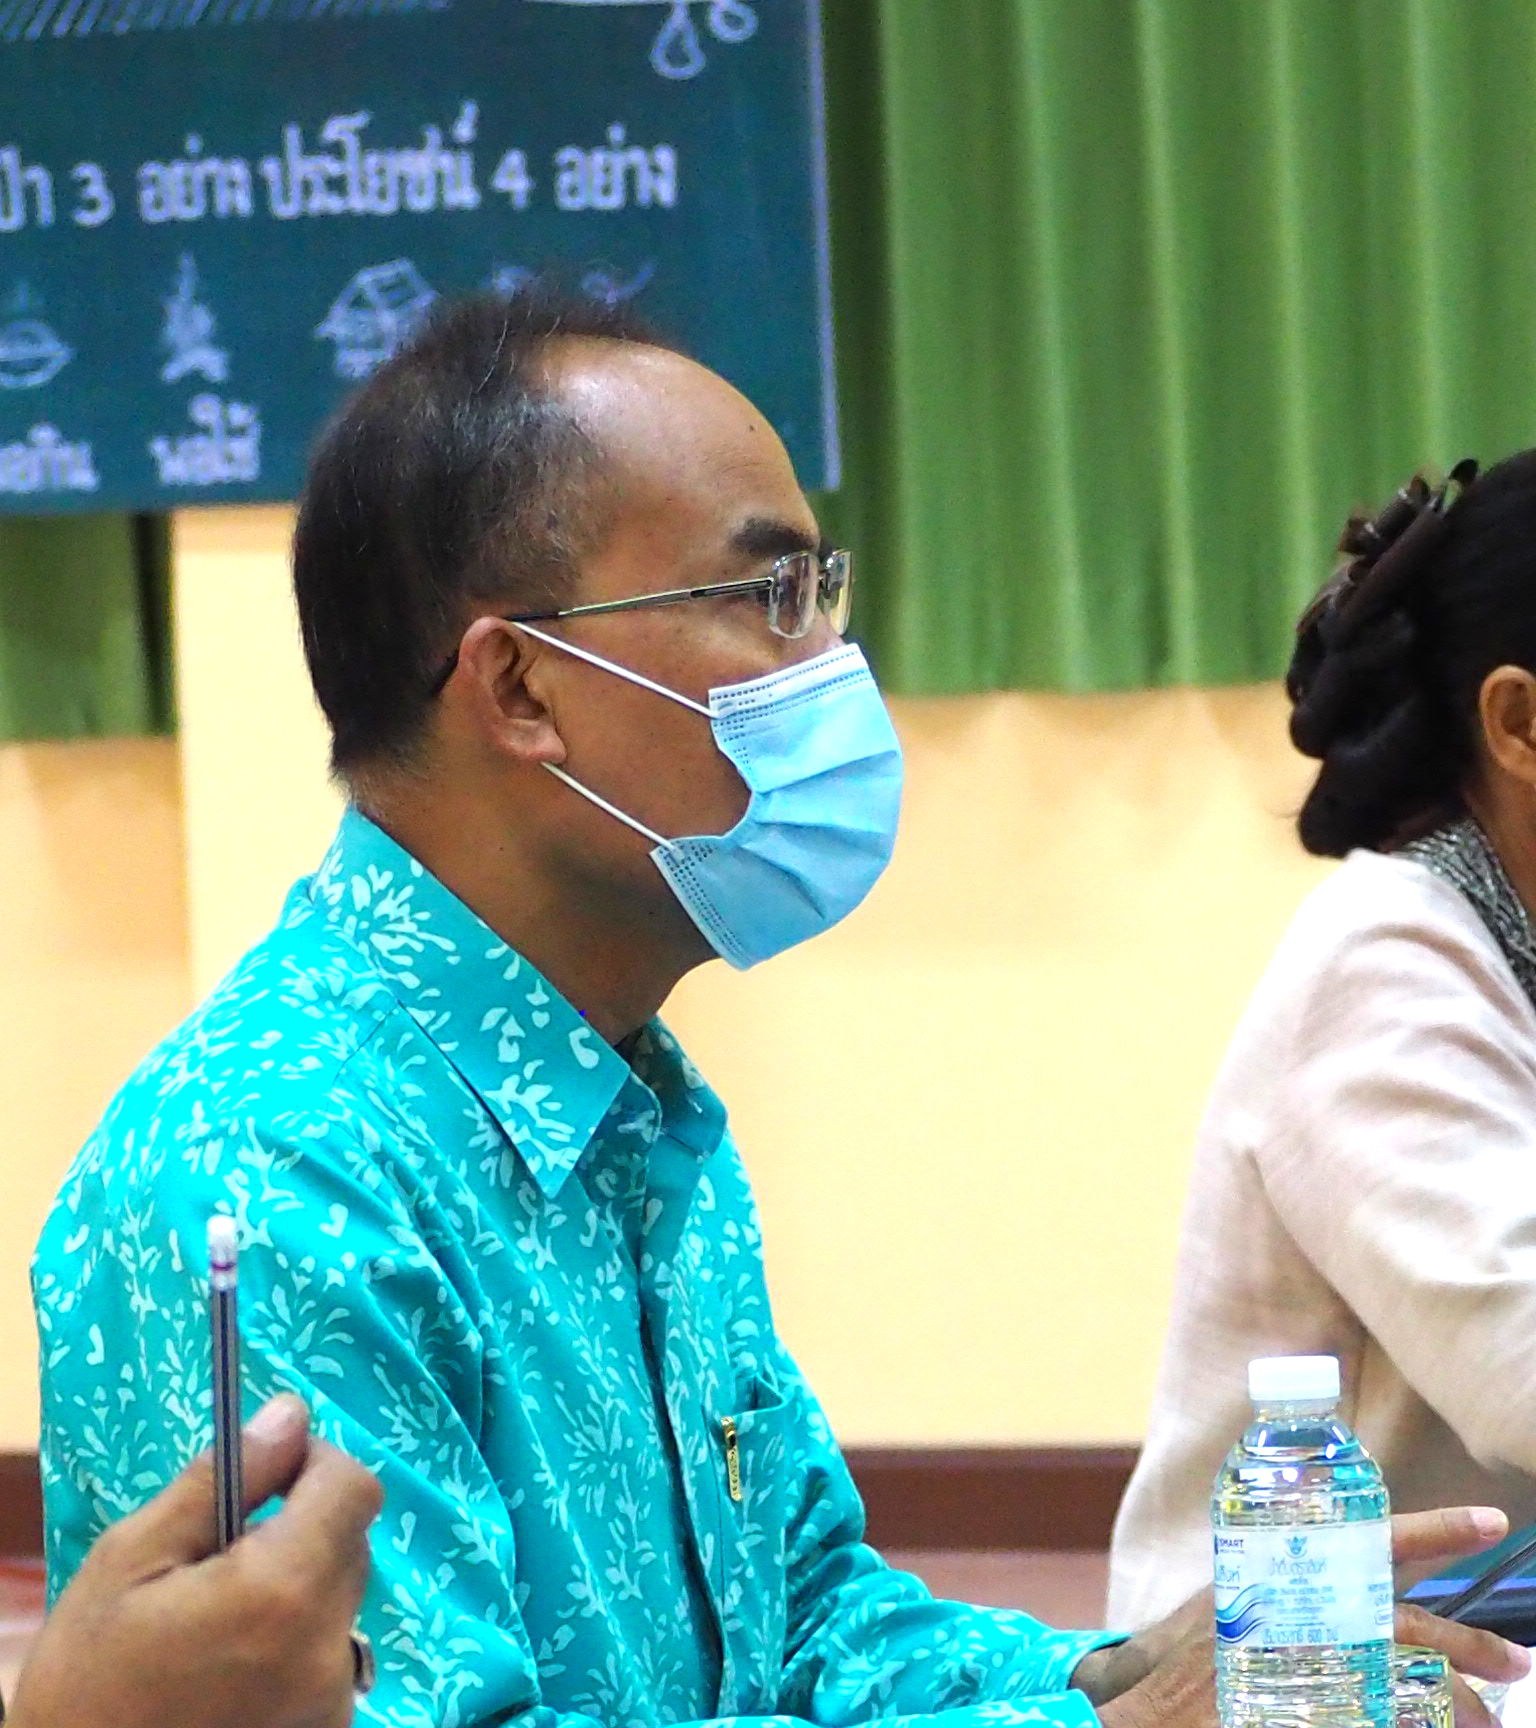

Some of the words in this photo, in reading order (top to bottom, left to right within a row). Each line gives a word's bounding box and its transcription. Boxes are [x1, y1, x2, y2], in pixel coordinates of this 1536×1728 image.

[71, 160, 115, 228] 3
[137, 131, 253, 223] อย่าง
[259, 100, 481, 219] ประโยชน์
[490, 148, 534, 211] 4
[553, 120, 677, 211] อย่าง
